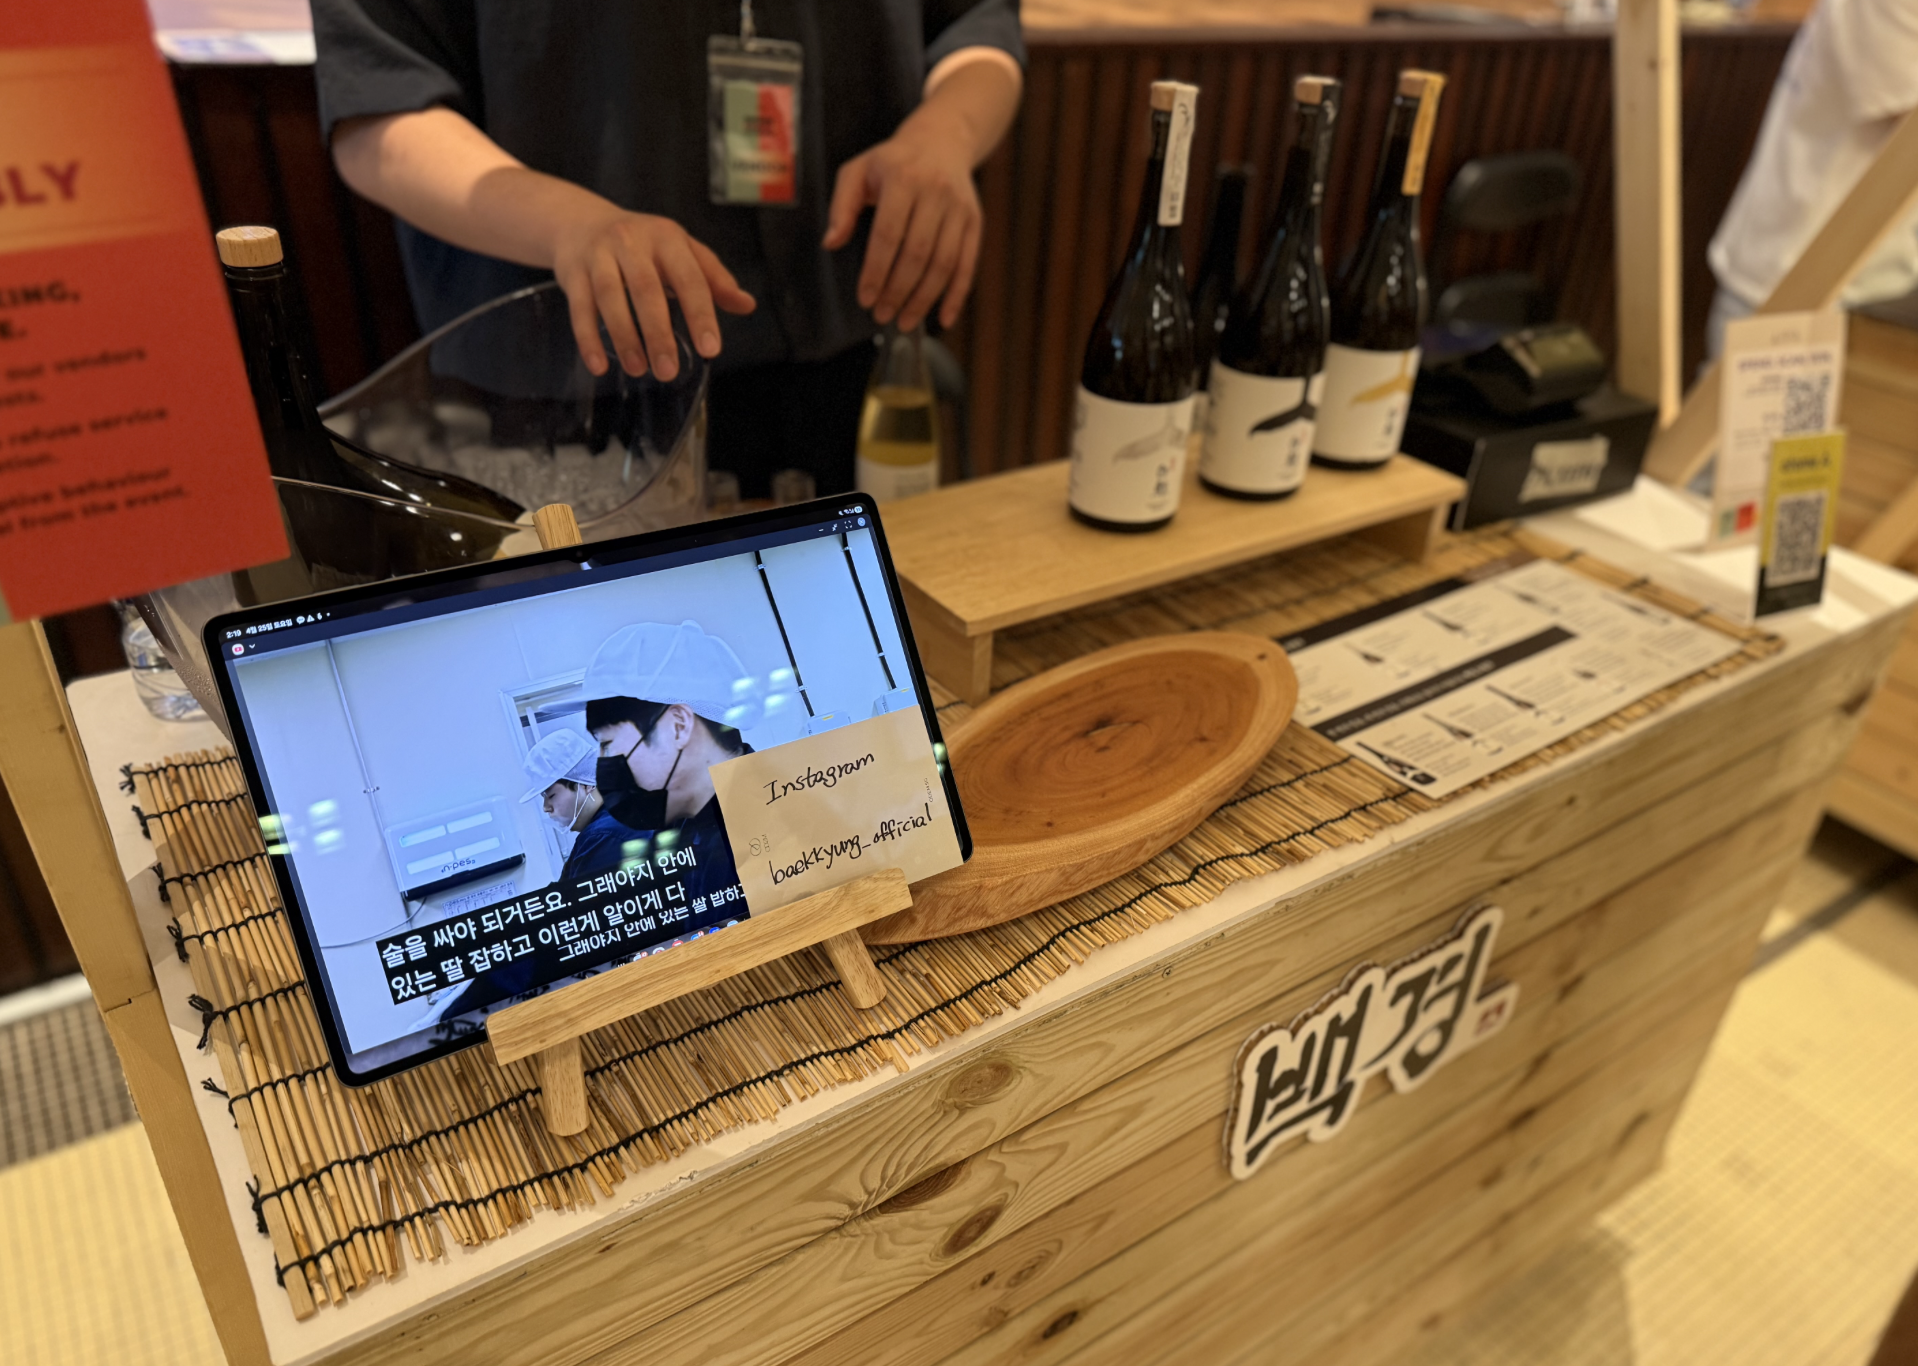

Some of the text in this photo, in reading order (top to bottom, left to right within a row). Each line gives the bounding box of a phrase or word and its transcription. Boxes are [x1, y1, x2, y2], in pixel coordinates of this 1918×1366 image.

[0, 159, 80, 207] LY
[763, 753, 875, 806] Instagram
[382, 934, 428, 969] 술을
[433, 917, 477, 948] 싸야
[481, 891, 572, 934] 되거든요.
[576, 860, 655, 902] 그래야지
[658, 846, 697, 876] 안에
[391, 881, 686, 1001] 있는 딸 잡하고 이런게 알이게 다
[558, 929, 622, 962] 그래야지
[624, 914, 656, 939] 안에
[658, 905, 690, 926] 있는
[692, 896, 708, 915] 쌀
[1244, 922, 1493, 1168] 백경
